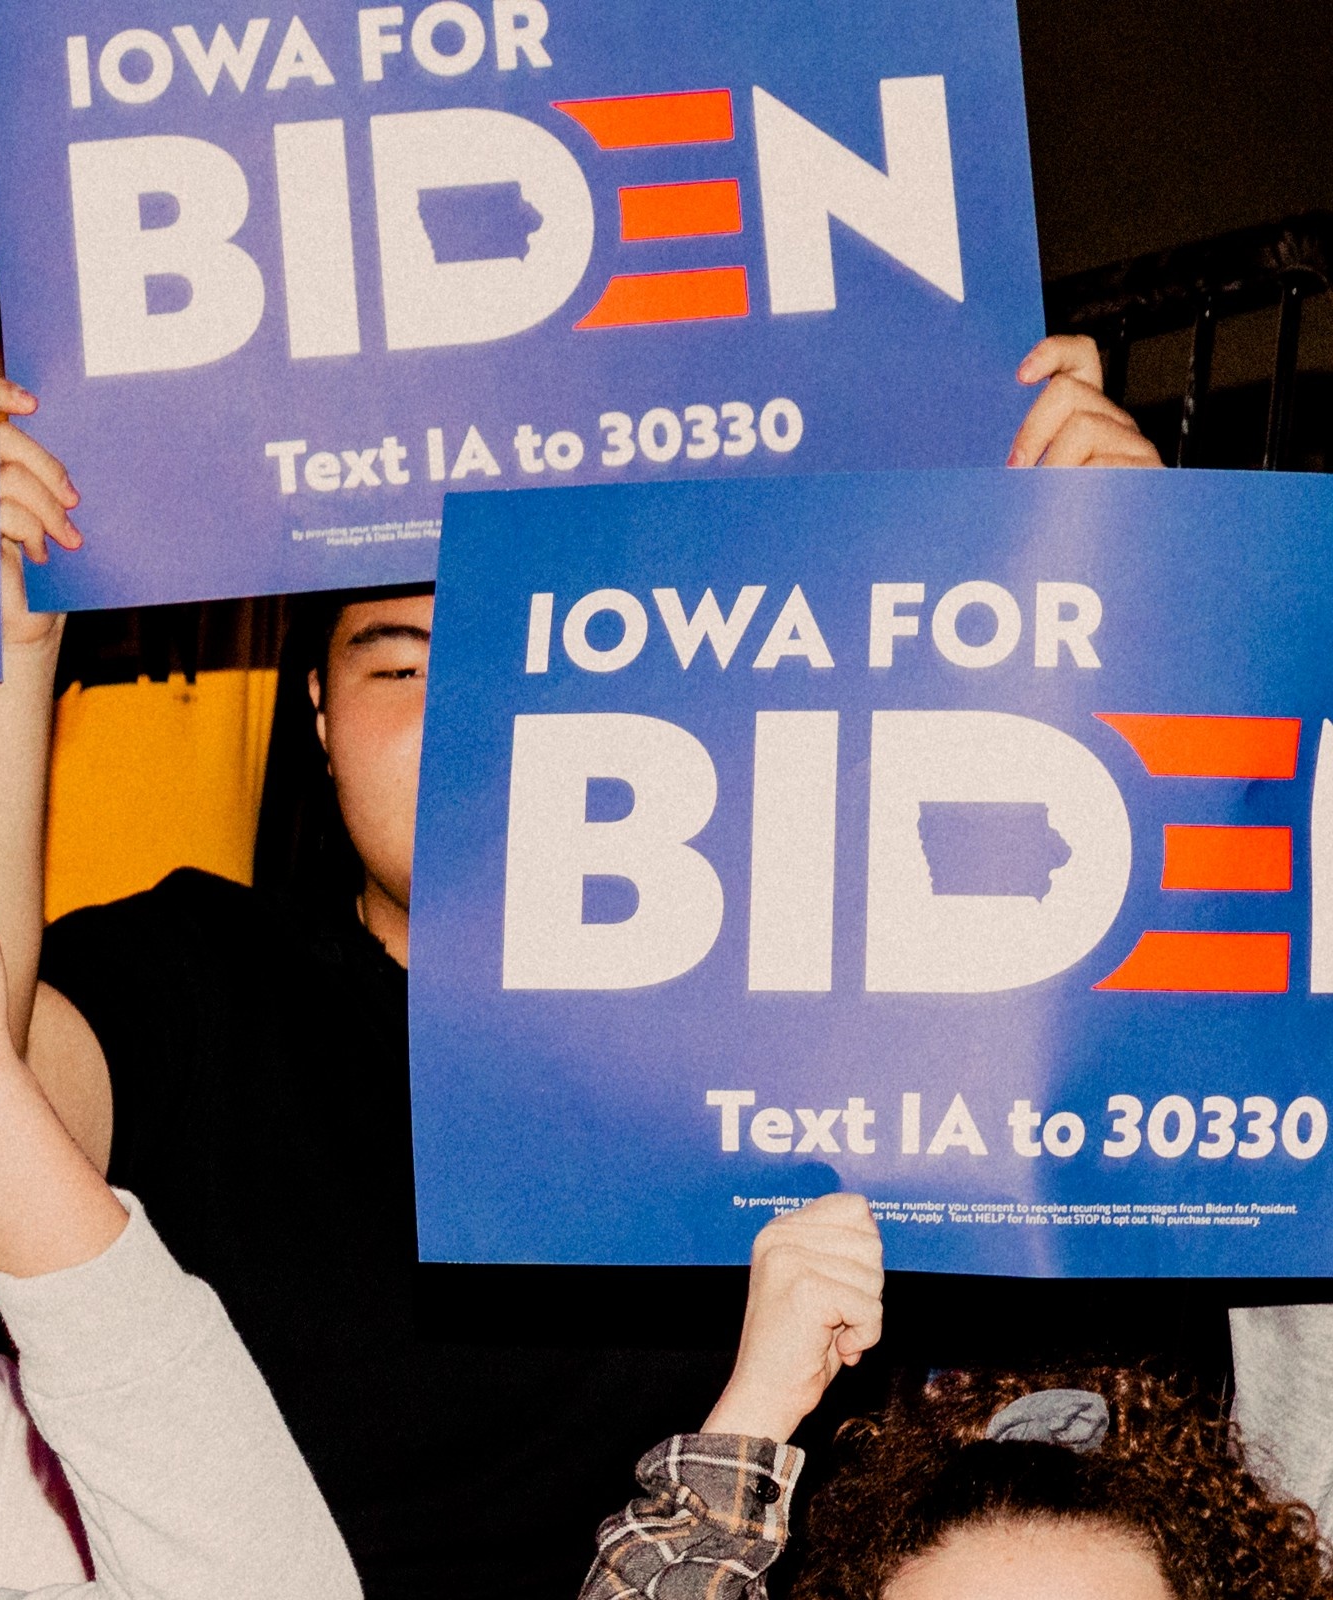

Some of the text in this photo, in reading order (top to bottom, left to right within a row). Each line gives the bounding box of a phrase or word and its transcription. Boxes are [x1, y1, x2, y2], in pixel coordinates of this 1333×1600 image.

[66, 0, 552, 109] IOWA FOR
[68, 74, 965, 378] BIDEN
[264, 398, 804, 494] Text IA to 30330
[525, 581, 1103, 673] IOWA FOR
[503, 709, 1333, 994] BIDE
[706, 1089, 1330, 1161] Text IA to 30330
[733, 1194, 746, 1209] By
[749, 1194, 799, 1208] providing
[903, 1199, 945, 1210] number
[948, 1203, 968, 1214] you
[971, 1203, 1014, 1212] consent
[1017, 1203, 1028, 1213] to
[1031, 1202, 1067, 1213] receive
[1069, 1202, 1111, 1216] recurring
[1113, 1203, 1131, 1213] text
[1133, 1205, 1177, 1216] messages
[1180, 1202, 1203, 1213] from
[1205, 1202, 1232, 1213] Biden
[1235, 1202, 1249, 1213] for
[1251, 1202, 1298, 1214] President.
[886, 1210, 908, 1224] May
[911, 1210, 944, 1225] Apply.
[949, 1211, 972, 1223] Text
[976, 1211, 1005, 1223] HELP
[1008, 1212, 1023, 1224] for
[1052, 1213, 1072, 1224] Text
[1074, 1213, 1099, 1224] STOP
[1101, 1215, 1111, 1225] to
[1113, 1215, 1129, 1228] opt
[1152, 1214, 1165, 1225] No
[1168, 1214, 1211, 1227] purchase
